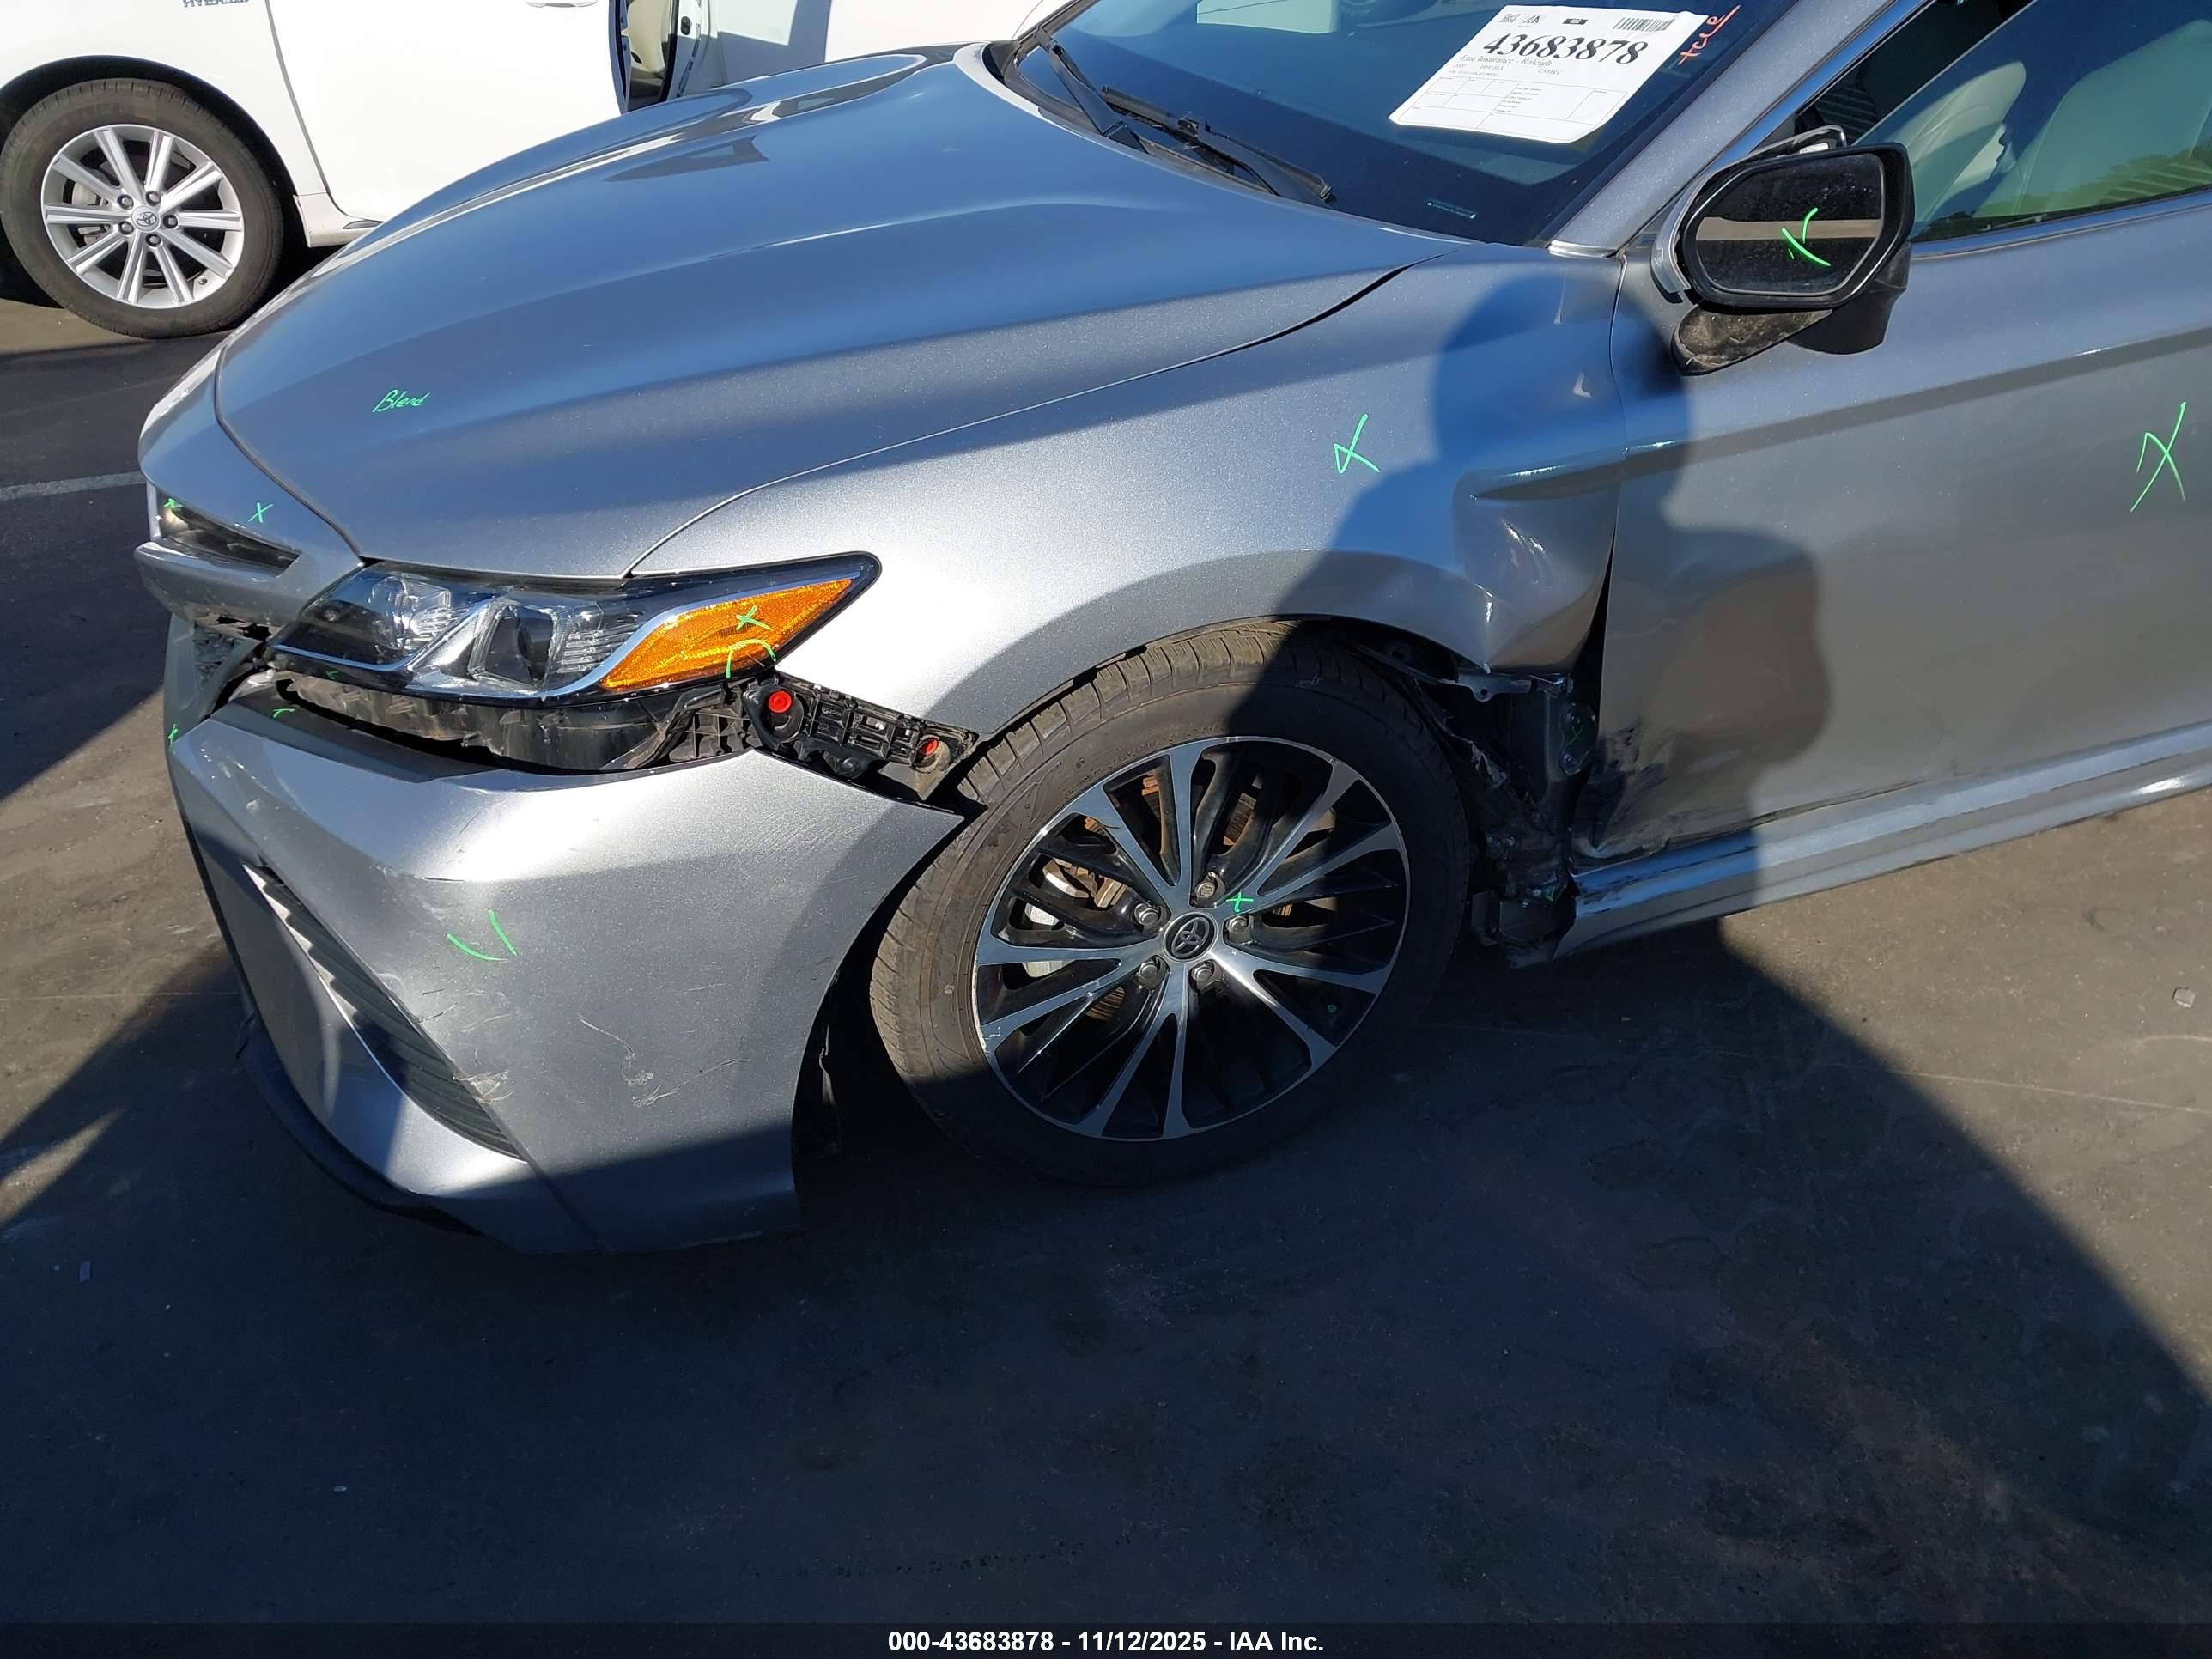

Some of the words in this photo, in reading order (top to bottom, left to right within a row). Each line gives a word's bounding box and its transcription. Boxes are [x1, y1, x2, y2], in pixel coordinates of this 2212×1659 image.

[1483, 33, 1649, 64] 43683878
[1477, 55, 1514, 64] Insurance
[1521, 58, 1553, 68] Raleigh
[372, 389, 431, 413] Blend
